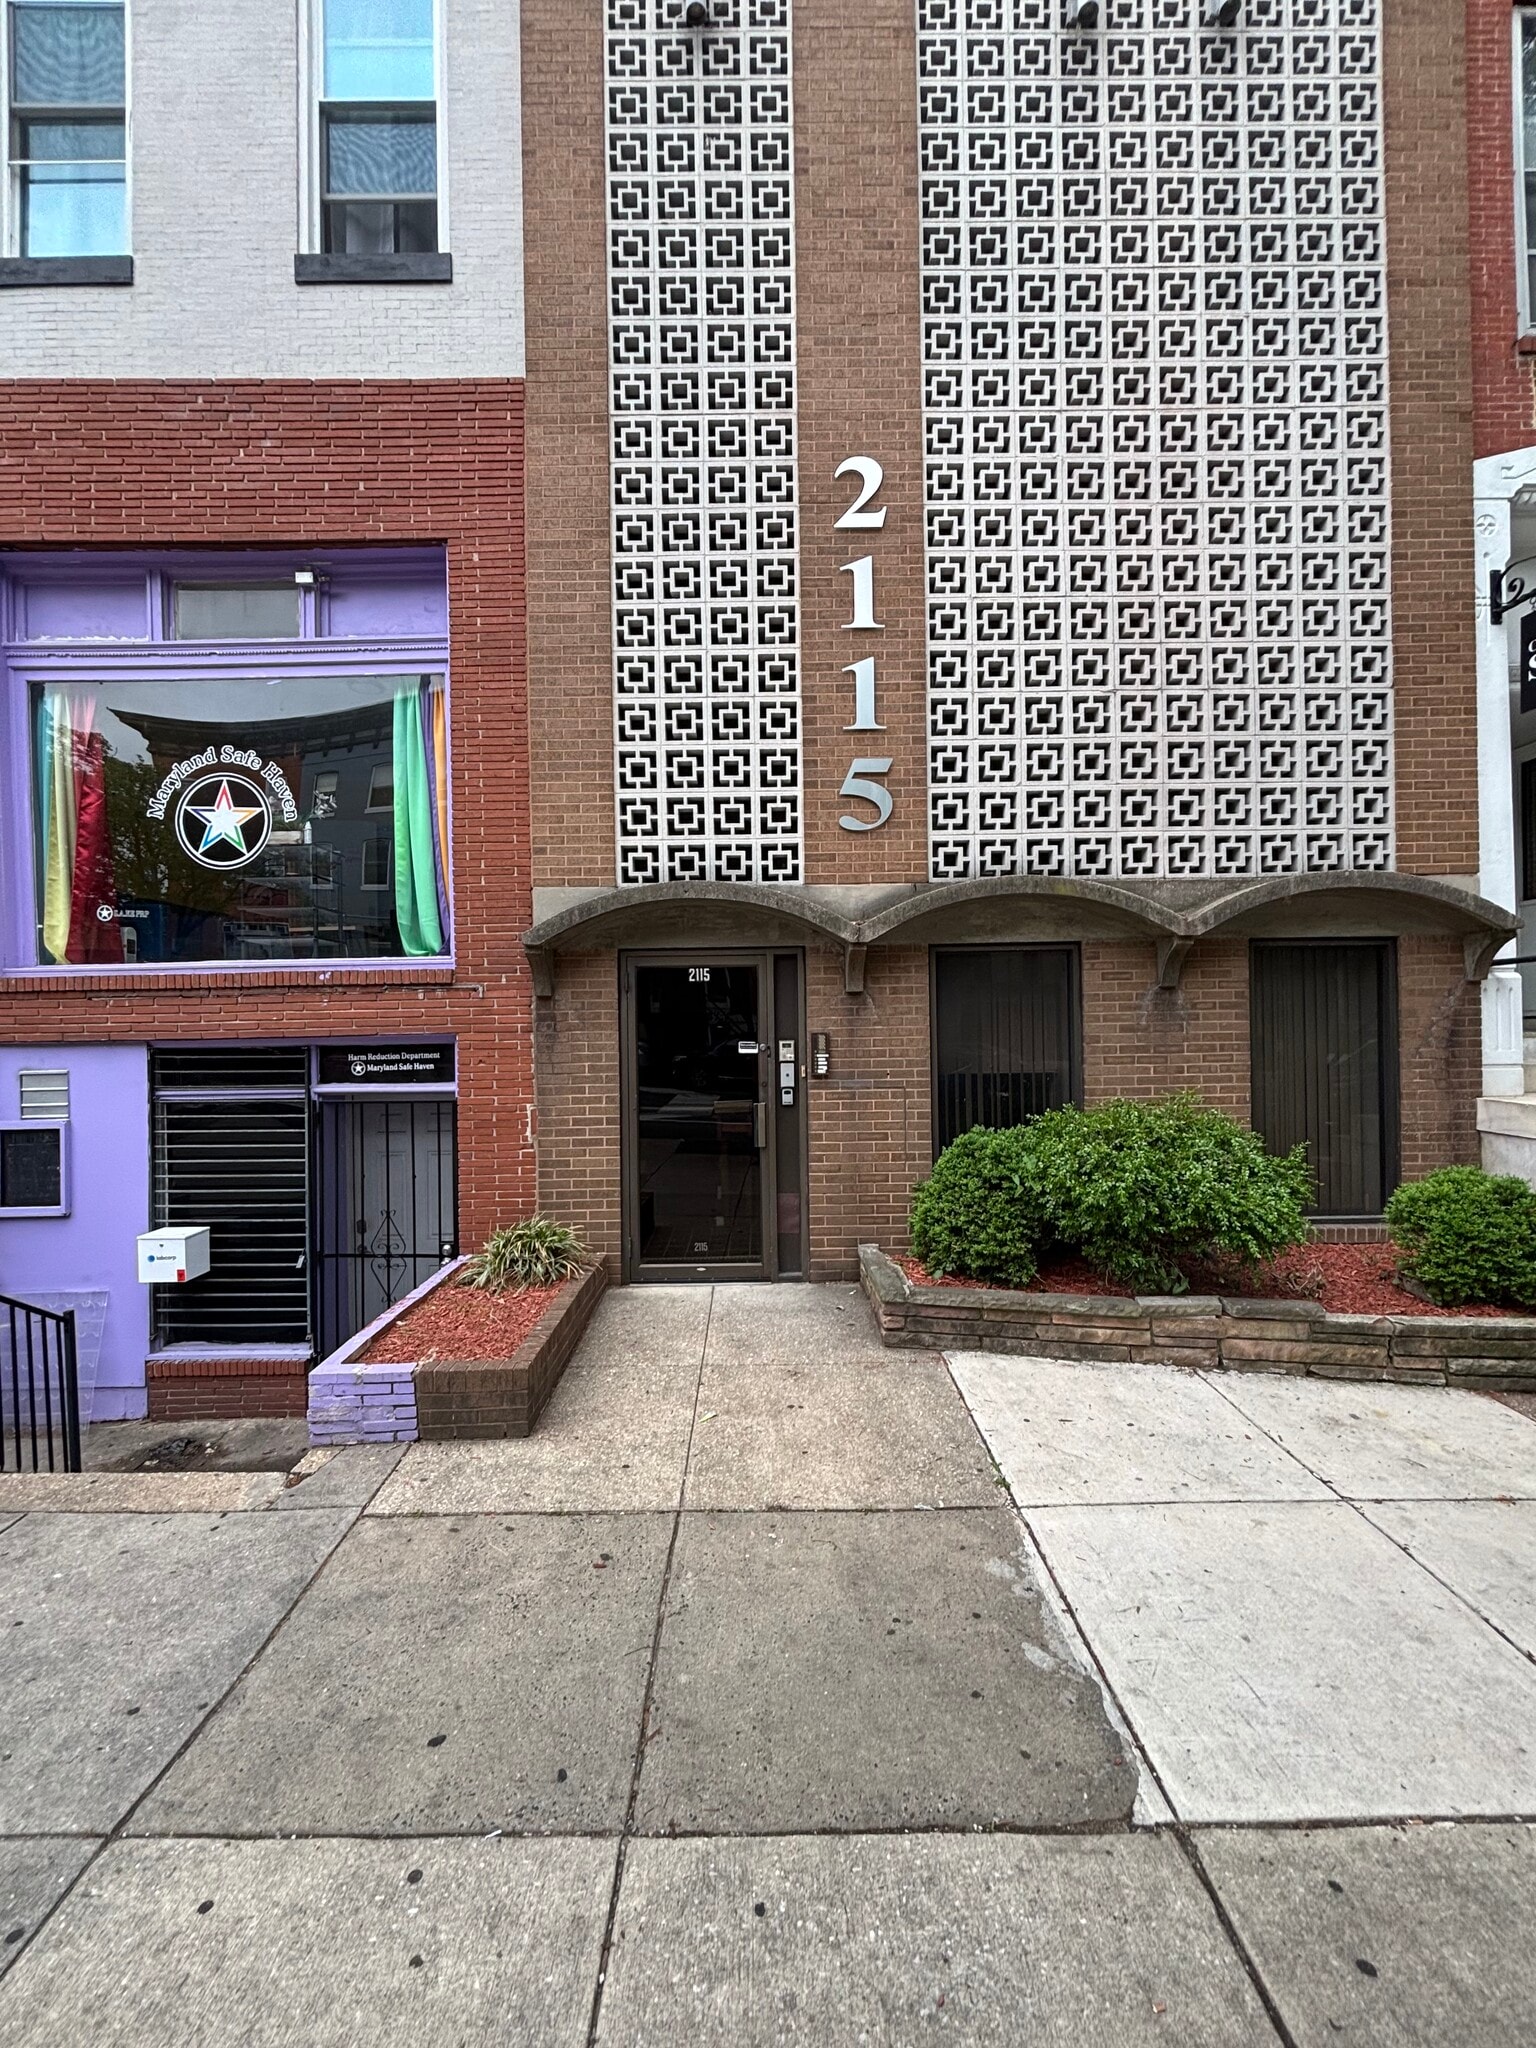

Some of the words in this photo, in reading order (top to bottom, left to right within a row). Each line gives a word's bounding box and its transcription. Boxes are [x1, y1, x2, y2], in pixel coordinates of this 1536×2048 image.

[832, 455, 894, 831] 2115
[147, 746, 218, 820] Maryland
[220, 745, 262, 771] Safe
[260, 761, 298, 822] Haven
[688, 967, 710, 982] 2115
[347, 1053, 367, 1061] Harm
[367, 1052, 401, 1061] Reduction
[401, 1052, 440, 1060] Department
[366, 1063, 398, 1073] Maryland
[398, 1062, 413, 1071] Safe
[413, 1062, 435, 1070] Haven
[694, 1241, 709, 1252] 2115
